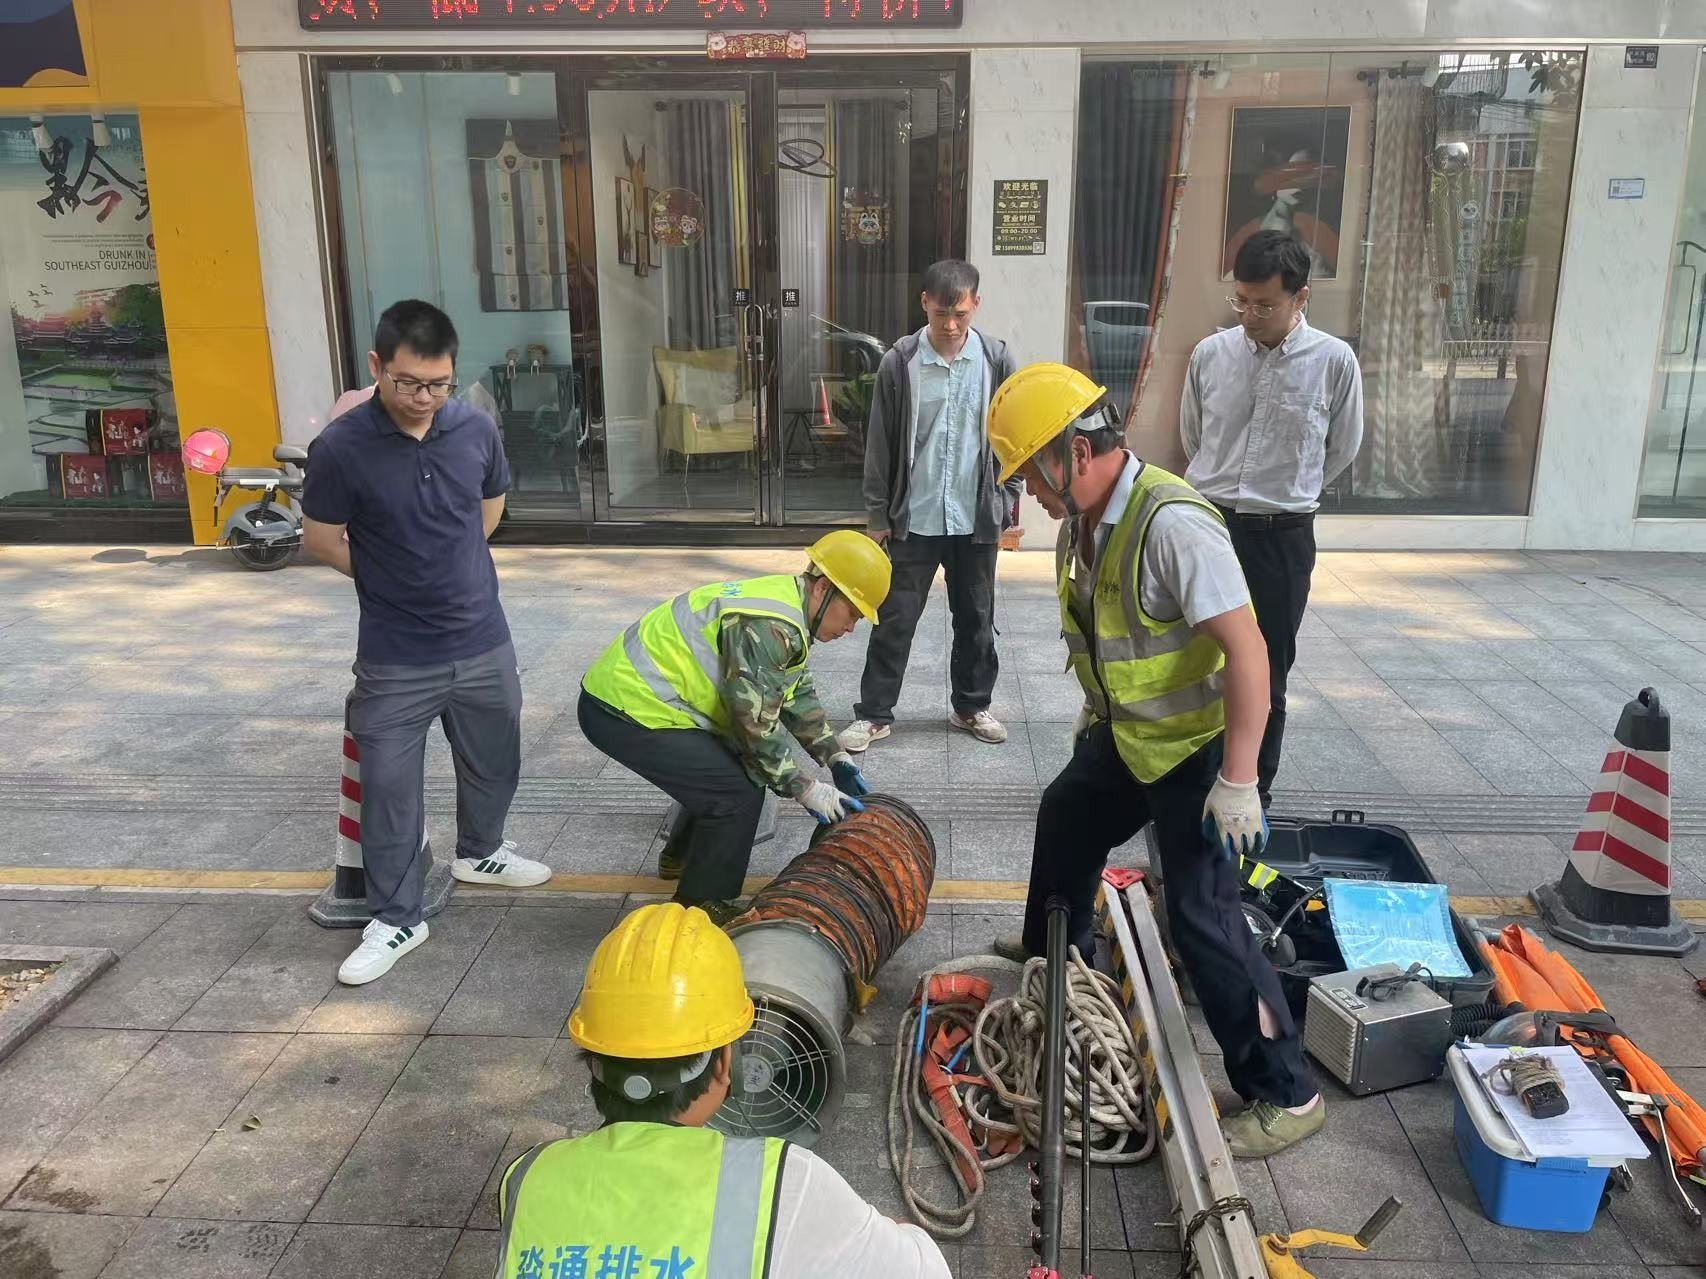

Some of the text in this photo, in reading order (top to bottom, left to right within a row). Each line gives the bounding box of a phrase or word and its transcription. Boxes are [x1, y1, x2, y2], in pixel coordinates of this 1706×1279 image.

[1003, 182, 1038, 191] 欢迎光临
[99, 250, 146, 260] DRUNK IN
[45, 261, 150, 271] SOUTHEAST GUIZHOU
[735, 290, 747, 301] 推
[785, 290, 796, 302] 推
[516, 1245, 696, 1279] 淼通排水
